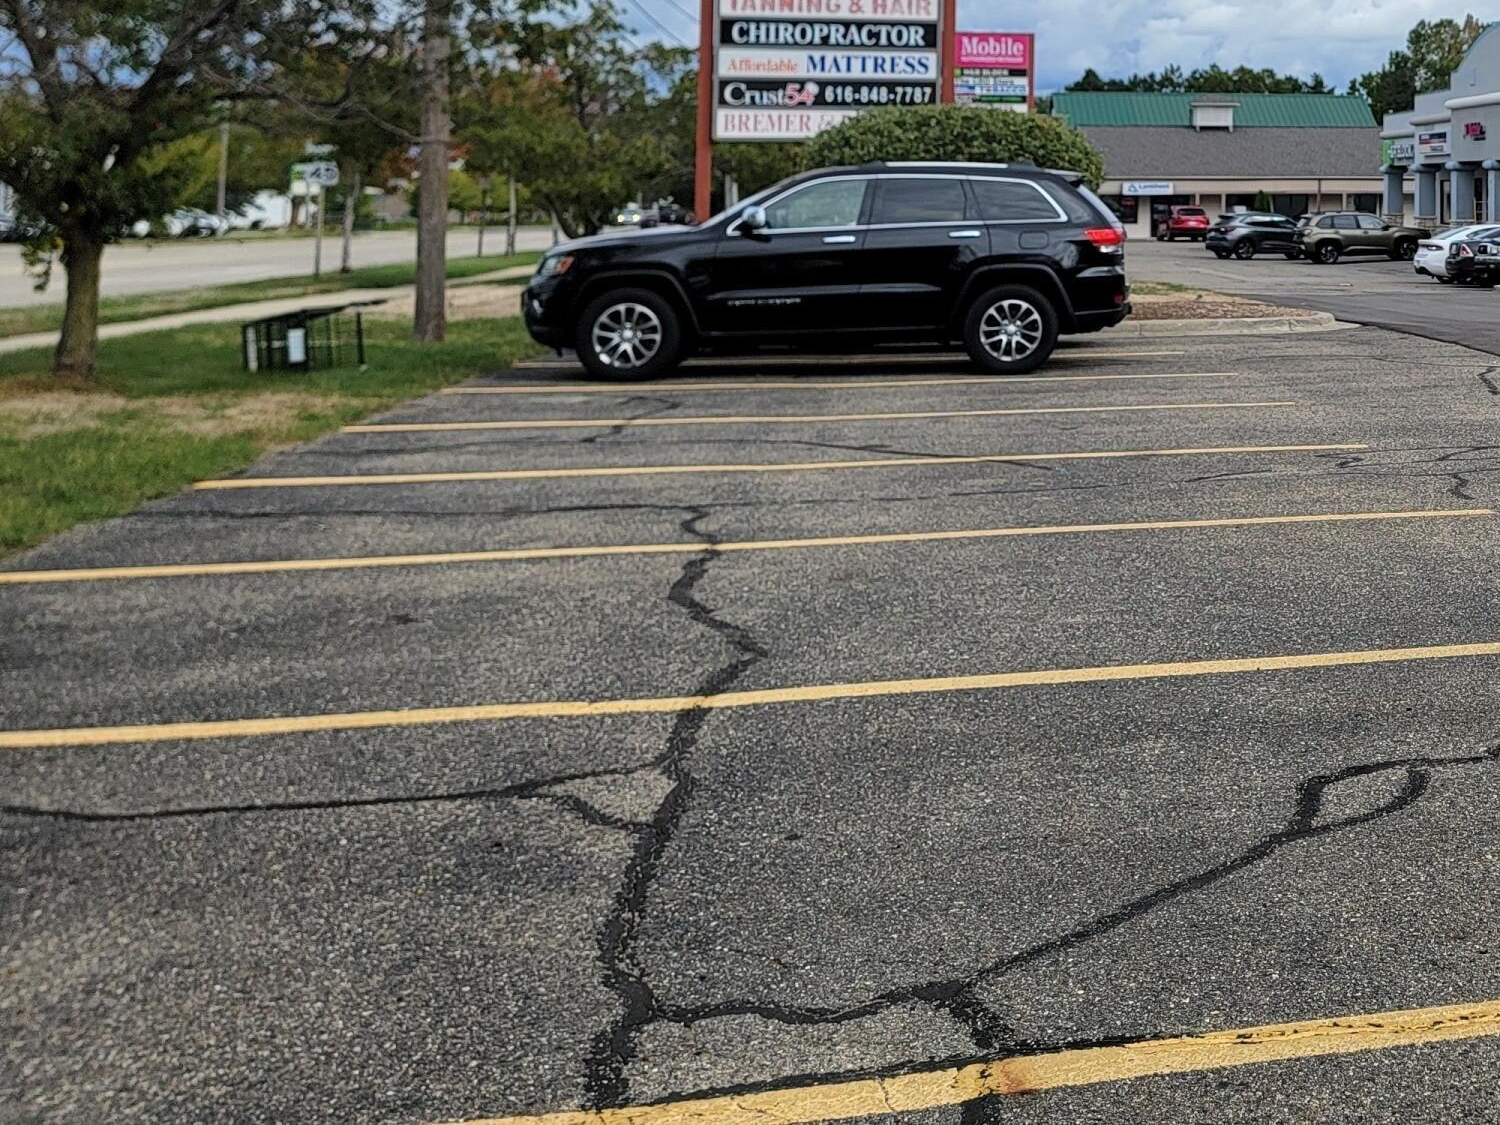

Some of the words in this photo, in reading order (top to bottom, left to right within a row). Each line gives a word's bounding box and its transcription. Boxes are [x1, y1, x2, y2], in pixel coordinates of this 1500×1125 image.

[731, 22, 926, 46] CHIROPRACTOR
[727, 58, 797, 72] Affordable
[806, 54, 929, 75] MATTRESS
[723, 113, 812, 133] BREMER
